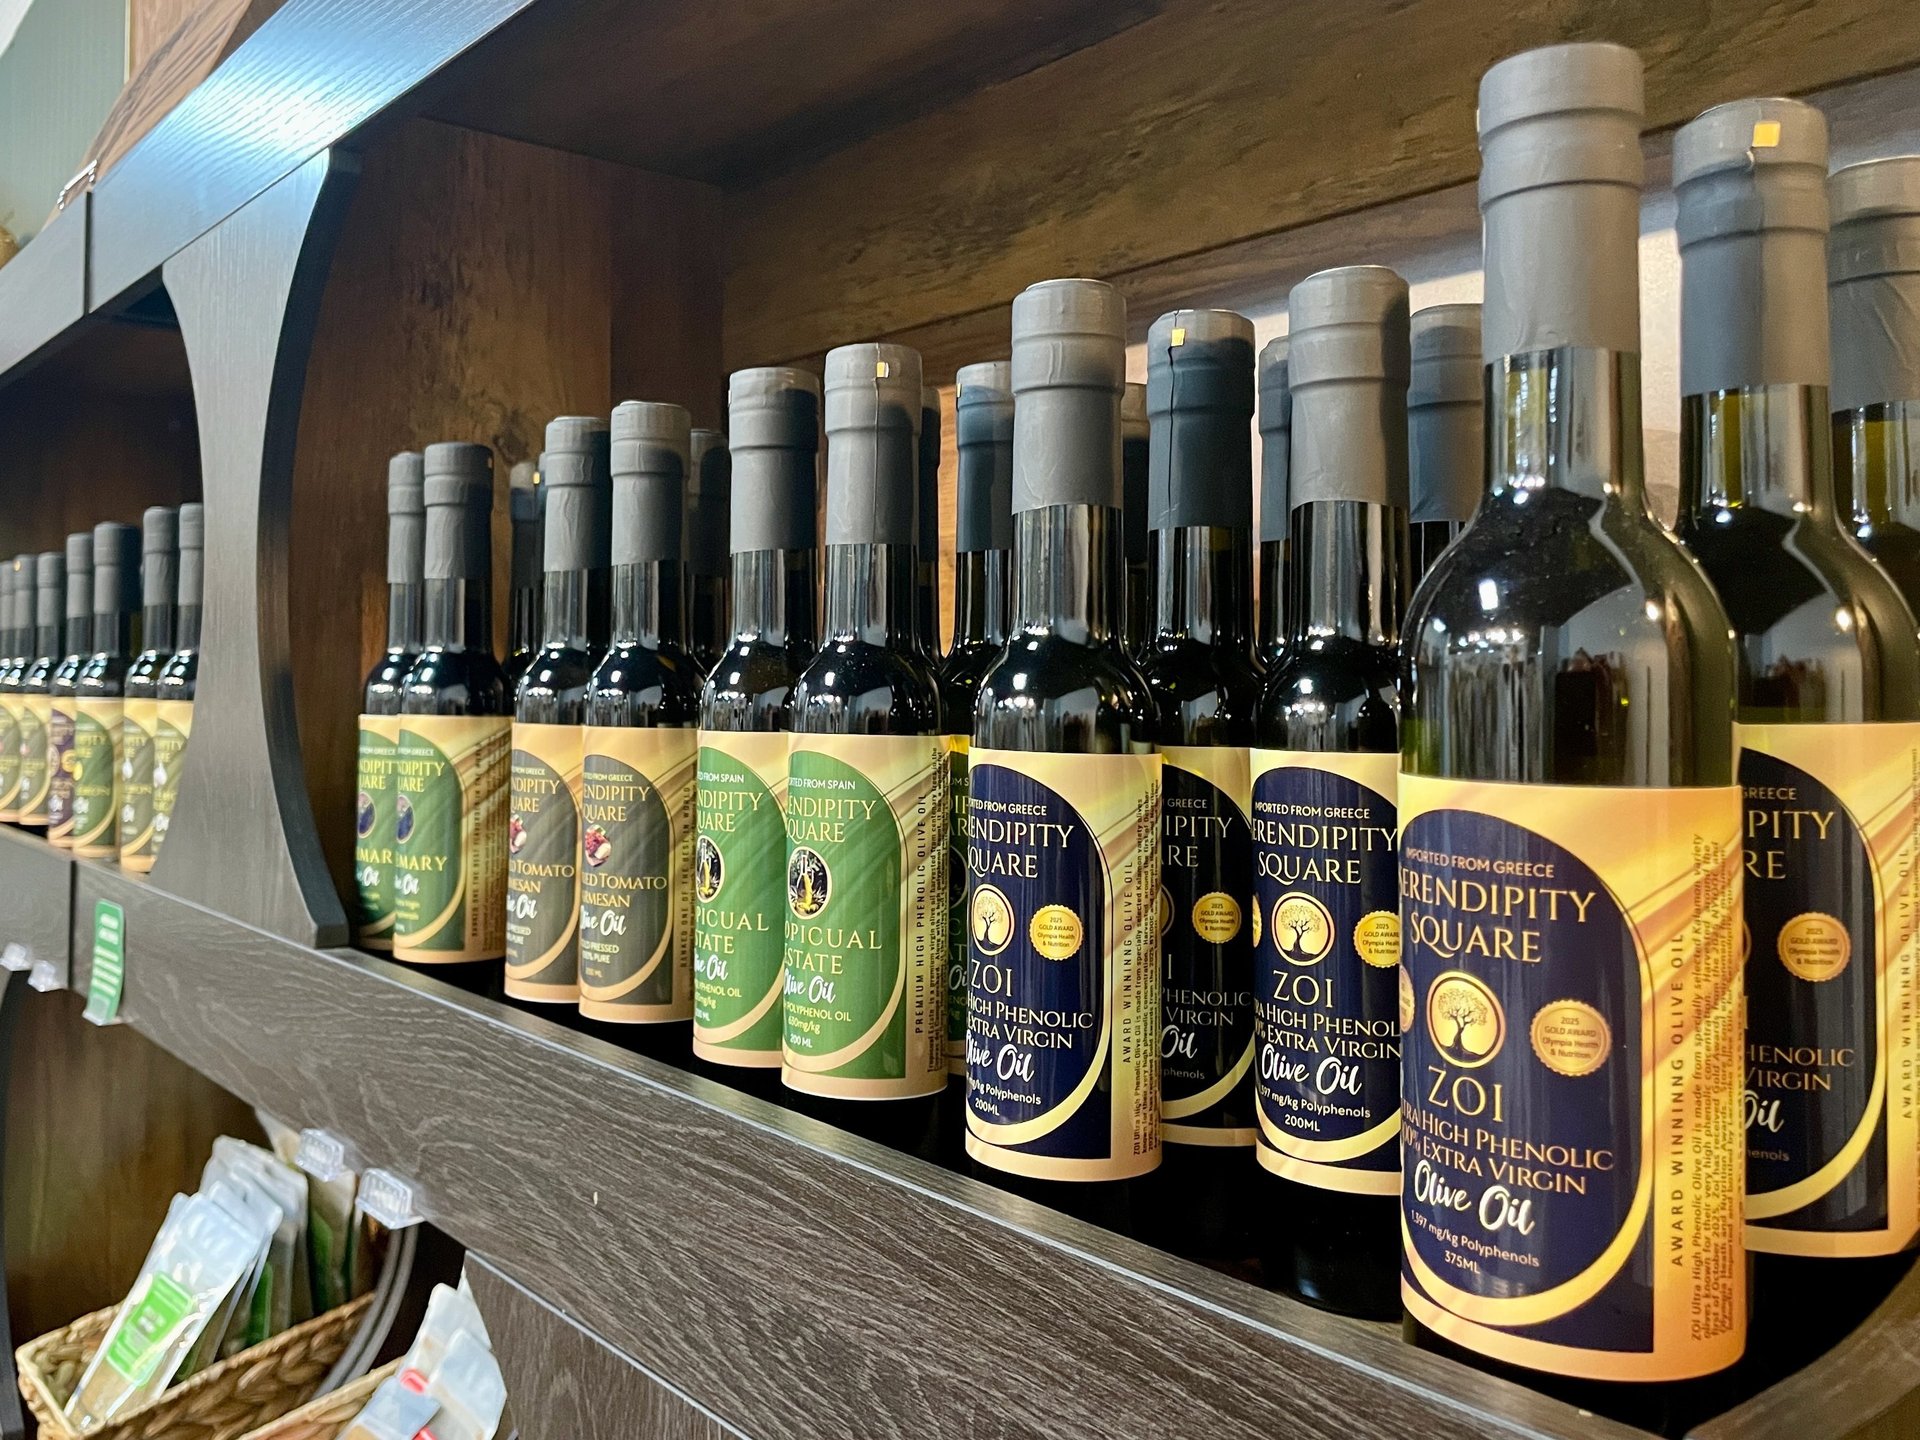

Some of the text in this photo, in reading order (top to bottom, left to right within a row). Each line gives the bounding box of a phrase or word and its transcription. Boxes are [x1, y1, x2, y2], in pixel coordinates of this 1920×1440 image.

[720, 773, 745, 783] SPAIN
[803, 779, 856, 790] FROM SPAIN
[984, 801, 1047, 816] FROM GREECE
[1167, 798, 1208, 809] GREECE
[1291, 804, 1370, 819] FROM GREECE
[1451, 855, 1555, 878] FROM GREECE
[1703, 844, 1712, 864] the
[516, 860, 575, 878] TOMATO
[598, 872, 668, 890] TOMATO
[1124, 862, 1133, 884] OIL
[1258, 851, 1362, 886] SQUARE
[600, 909, 627, 936] Oil
[915, 794, 927, 1034] PREMIUM HIGH PHENOLIC OLIVE OIL
[1124, 892, 1133, 931] OLIVE
[1039, 924, 1055, 932] GOLD
[1410, 911, 1542, 963] SQUARE
[1671, 935, 1684, 969] OIL
[706, 954, 729, 981] Oil
[971, 959, 1013, 997] ZOI
[726, 988, 742, 998] OIL
[808, 975, 836, 1004] Oil
[1273, 969, 1334, 1009] ZOI
[834, 1011, 852, 1022] OIL
[967, 990, 1094, 1029] HIGH PHENOLIC
[1166, 1006, 1234, 1027] VIRGIN
[1266, 1002, 1307, 1029] HIGH
[1560, 1016, 1580, 1026] 2025
[1671, 982, 1684, 1045] OLIVE
[968, 1011, 1073, 1049] EXTRA VIRGIN
[1123, 1018, 1132, 1064] AWARD
[1267, 1024, 1401, 1060] EXTRA VIRGIN
[1543, 1037, 1573, 1049] Olympia
[1544, 1026, 1598, 1038] GOLD AWARD
[996, 1043, 1035, 1083] Oil
[1550, 1048, 1556, 1057] &
[1261, 1043, 1363, 1096] Olive Oil
[985, 1083, 1042, 1105] Polyphenols
[1428, 1065, 1504, 1123] ZOI
[1691, 833, 1704, 1341] ZOI Ultra High Phenolic Olive Oil is made from specially selected Kalamon variety
[974, 1097, 1000, 1117] 200ML
[1271, 1092, 1371, 1118] mg/kg Polyphenols
[1702, 1084, 1713, 1137] phenolic
[1284, 1114, 1321, 1132] 200ML
[1422, 1110, 1615, 1170] HIGH PHENOLIC
[1423, 1136, 1587, 1195] EXTRA VIRGIN
[1702, 1141, 1713, 1169] high
[1414, 1159, 1535, 1235] Olive Oil
[1703, 1172, 1713, 1198] very
[1671, 1189, 1684, 1267] AWARD
[1702, 1202, 1711, 1231] their
[1428, 1223, 1458, 1248] mg/kg
[1461, 1234, 1540, 1268] Polyphenols
[1702, 1235, 1711, 1253] for
[1444, 1250, 1481, 1275] 375ML
